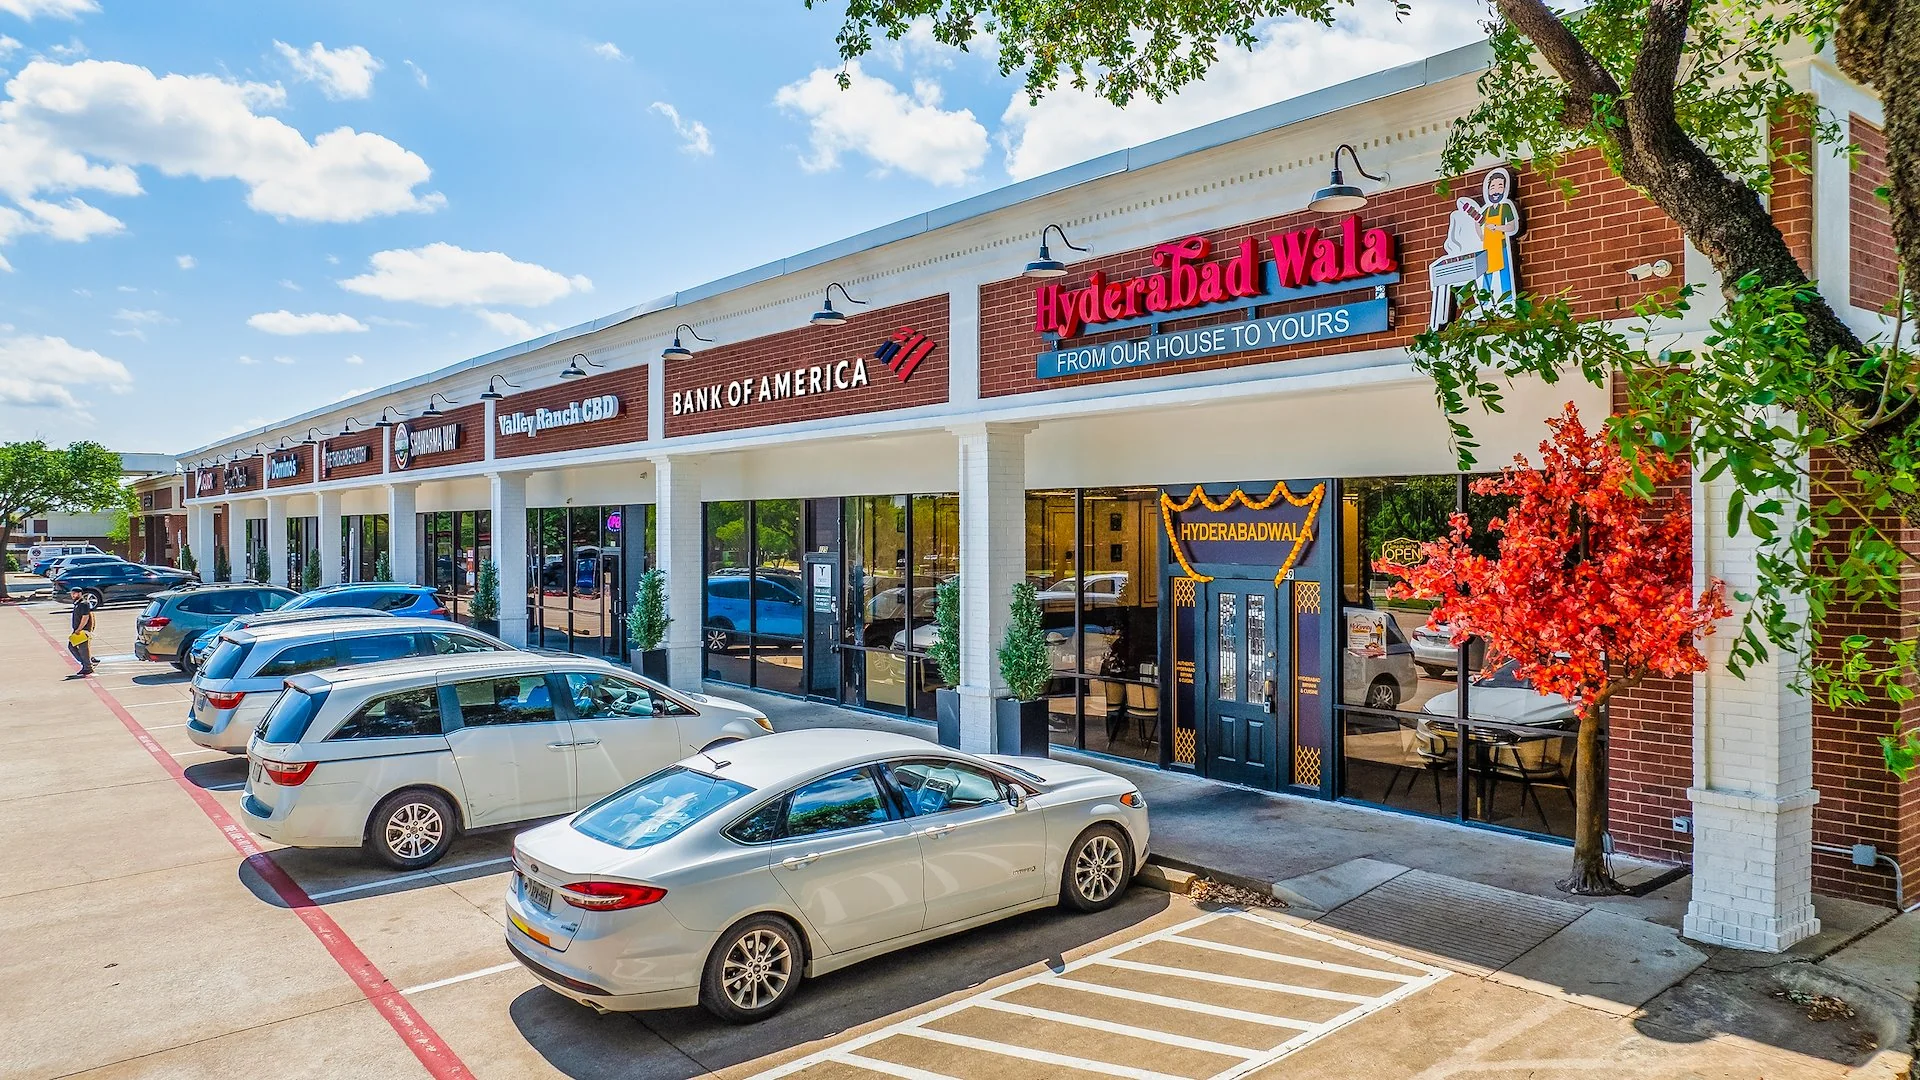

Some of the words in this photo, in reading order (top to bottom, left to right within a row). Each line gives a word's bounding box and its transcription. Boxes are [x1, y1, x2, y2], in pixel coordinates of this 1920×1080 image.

[1035, 236, 1261, 338] Hyderabad
[1268, 213, 1397, 288] Wala
[1056, 347, 1107, 373] FROM
[1110, 341, 1151, 365] OUR
[1156, 328, 1226, 359] HOUSE
[1231, 323, 1261, 348] TO
[1265, 309, 1350, 343] YOURS
[672, 384, 723, 416] BANK
[727, 378, 755, 406] OF
[758, 357, 869, 402] AMERICA
[498, 412, 537, 438] Valley
[536, 401, 584, 430] Ranch
[582, 395, 619, 422] CBD
[411, 426, 442, 457] SHAWARMA
[442, 423, 459, 451] WAY
[271, 453, 297, 480] Domino's
[1181, 522, 1314, 542] HYDERABADWALA
[1385, 548, 1421, 561] OPEN
